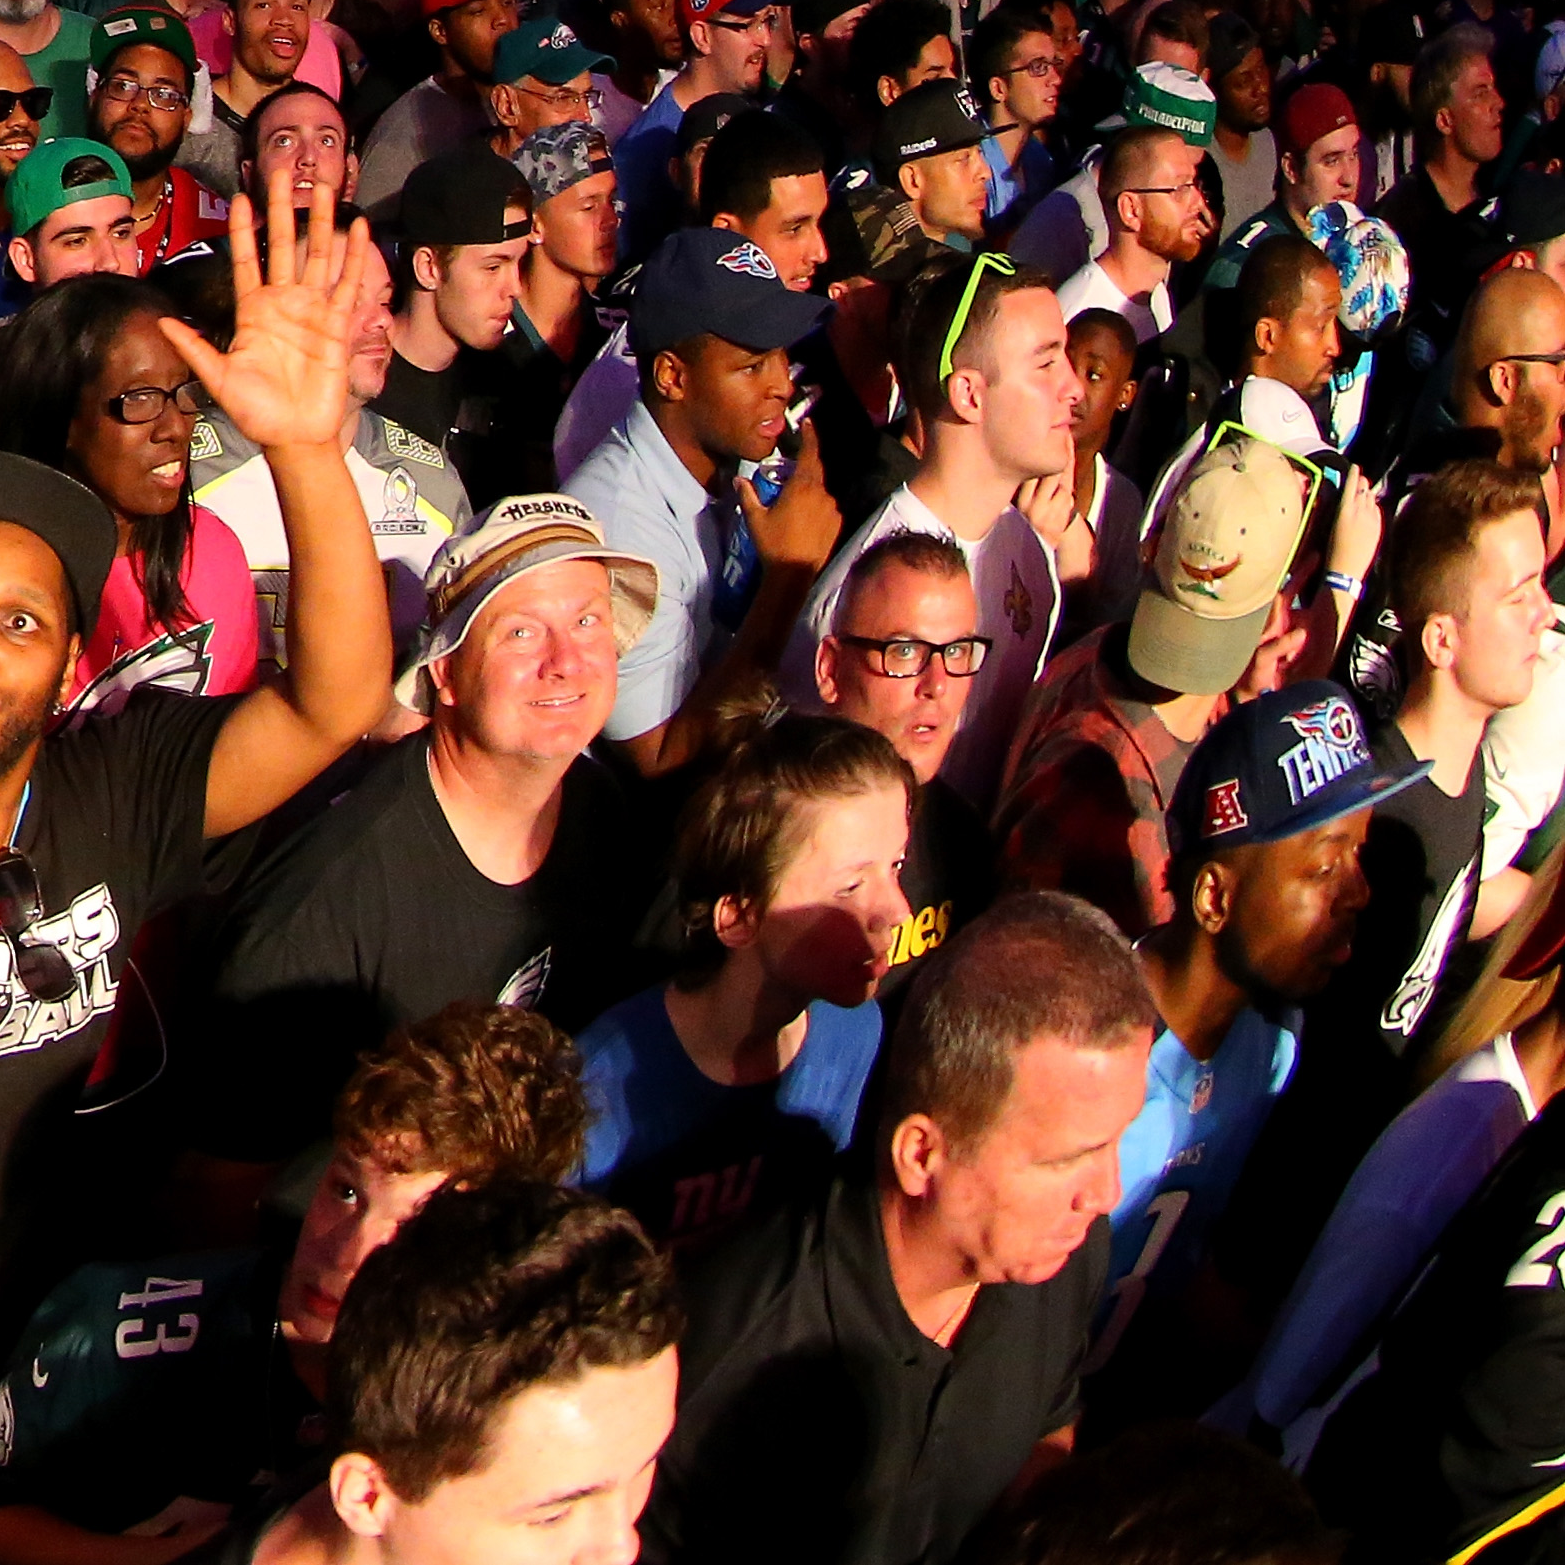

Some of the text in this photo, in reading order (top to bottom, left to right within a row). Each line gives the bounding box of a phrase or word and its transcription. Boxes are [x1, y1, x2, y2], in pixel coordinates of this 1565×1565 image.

[1138, 102, 1206, 135] PHILADELPHIA
[899, 136, 938, 156] RAIDERS
[115, 1275, 204, 1359] 43
